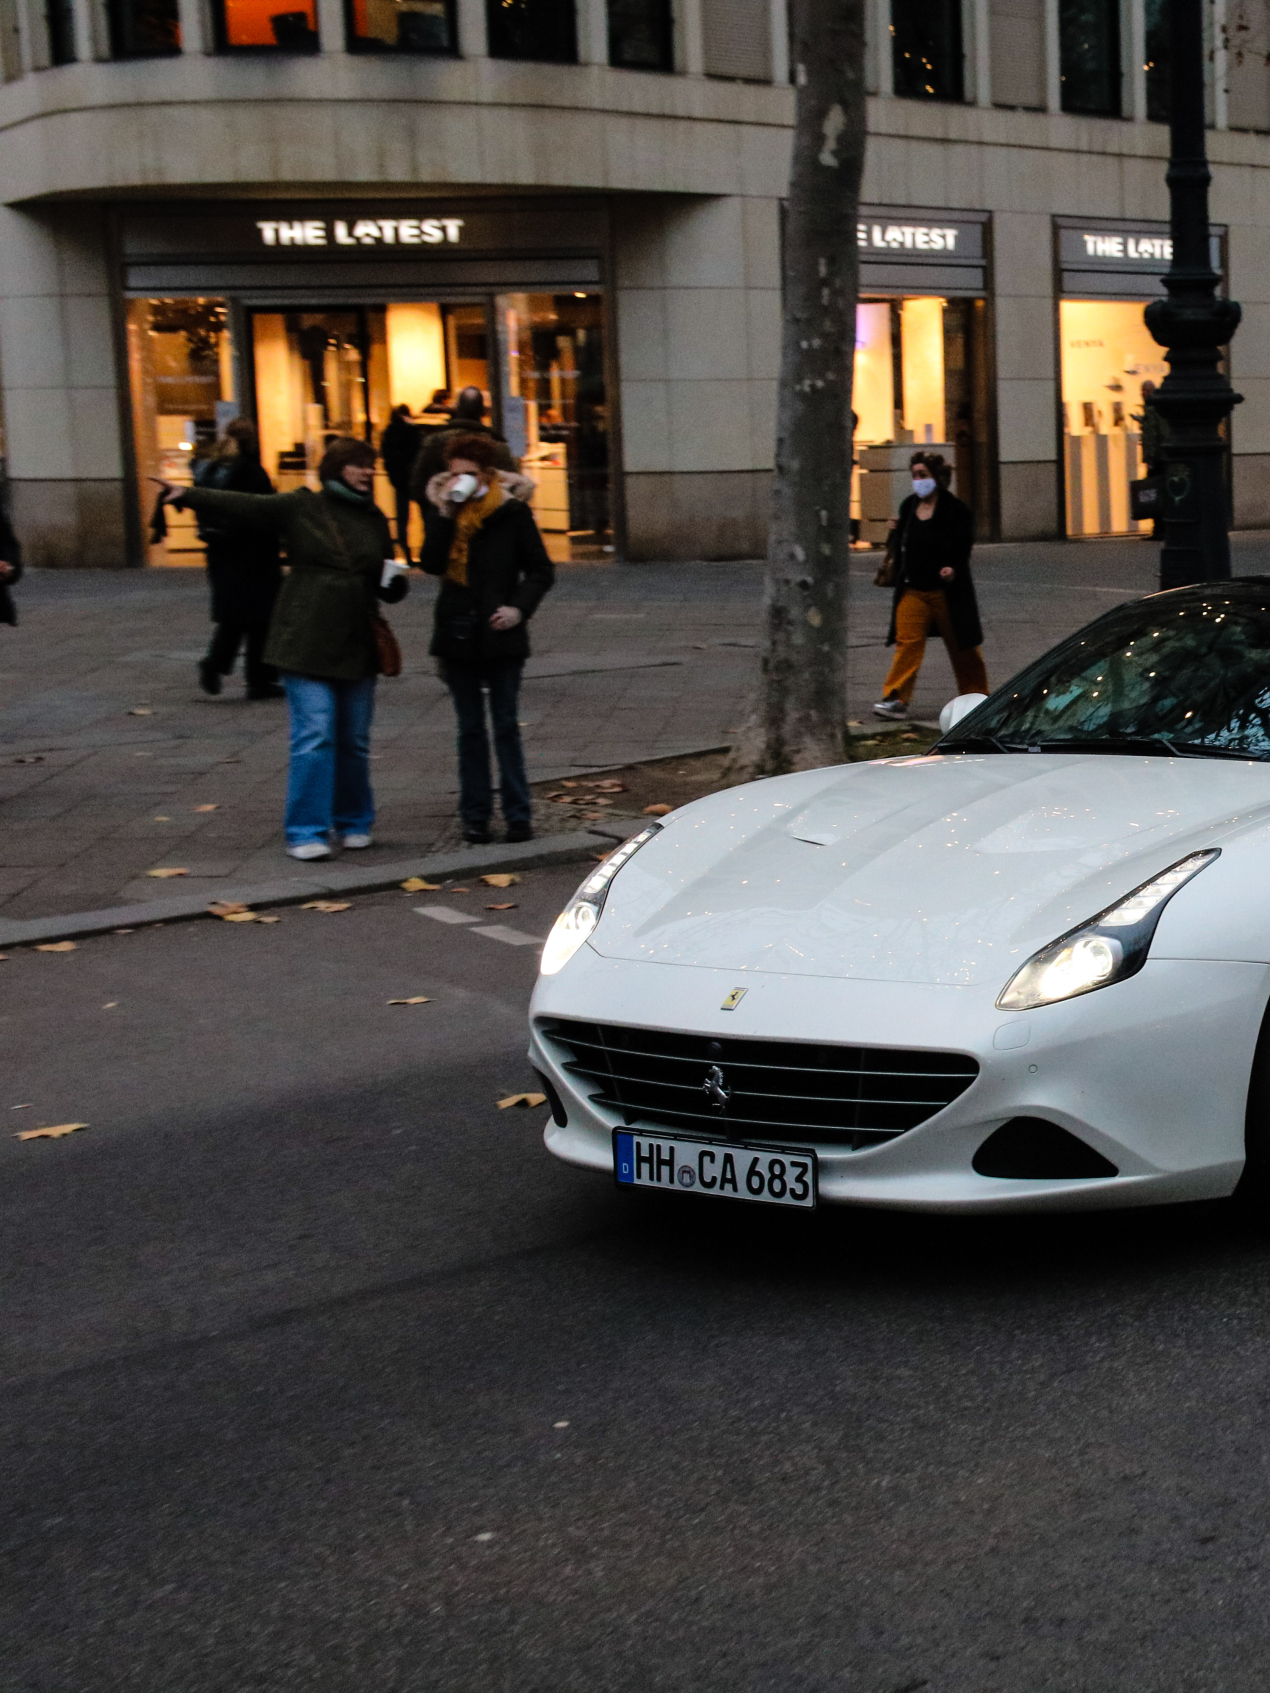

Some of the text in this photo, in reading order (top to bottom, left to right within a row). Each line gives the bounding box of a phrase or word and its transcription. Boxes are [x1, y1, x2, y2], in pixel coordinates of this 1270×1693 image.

[256, 218, 464, 245] THE LATEST
[872, 224, 958, 251] LATEST
[1083, 234, 1173, 260] THE LATE
[635, 1141, 675, 1185] HH
[698, 1150, 739, 1193] CA
[746, 1156, 810, 1201] 683
